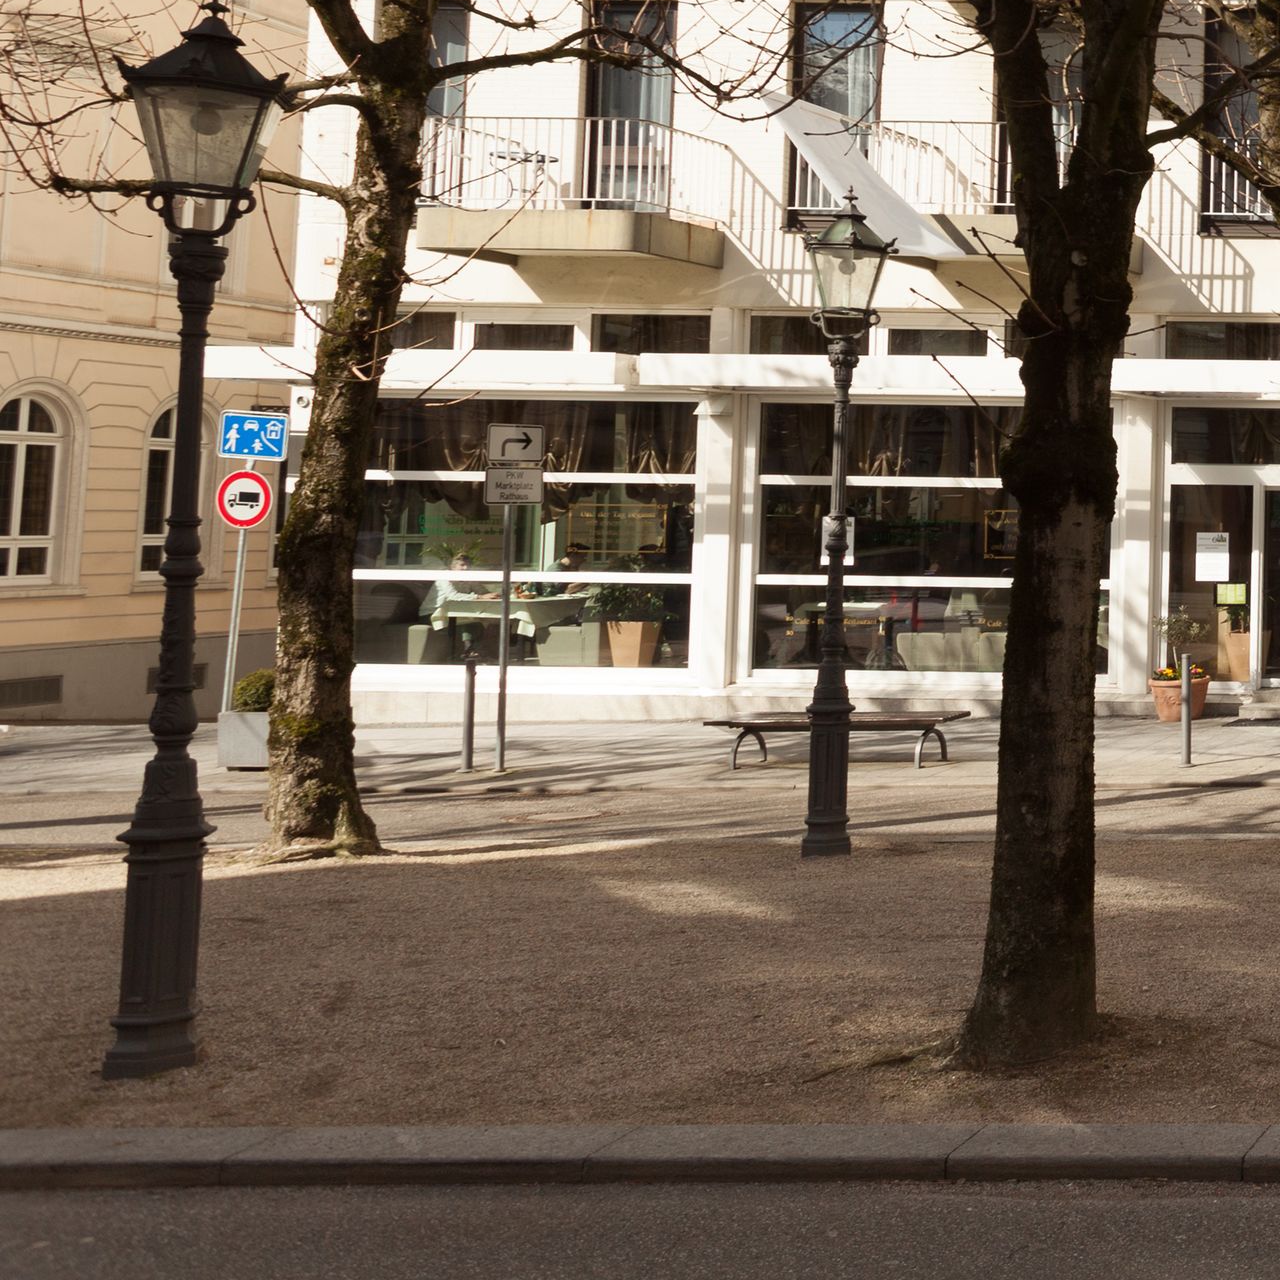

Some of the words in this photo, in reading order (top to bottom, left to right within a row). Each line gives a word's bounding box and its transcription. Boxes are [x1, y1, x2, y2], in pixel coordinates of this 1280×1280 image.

[505, 471, 524, 479] PKW
[495, 481, 534, 491] Marktplatz
[499, 492, 529, 500] Rathaus
